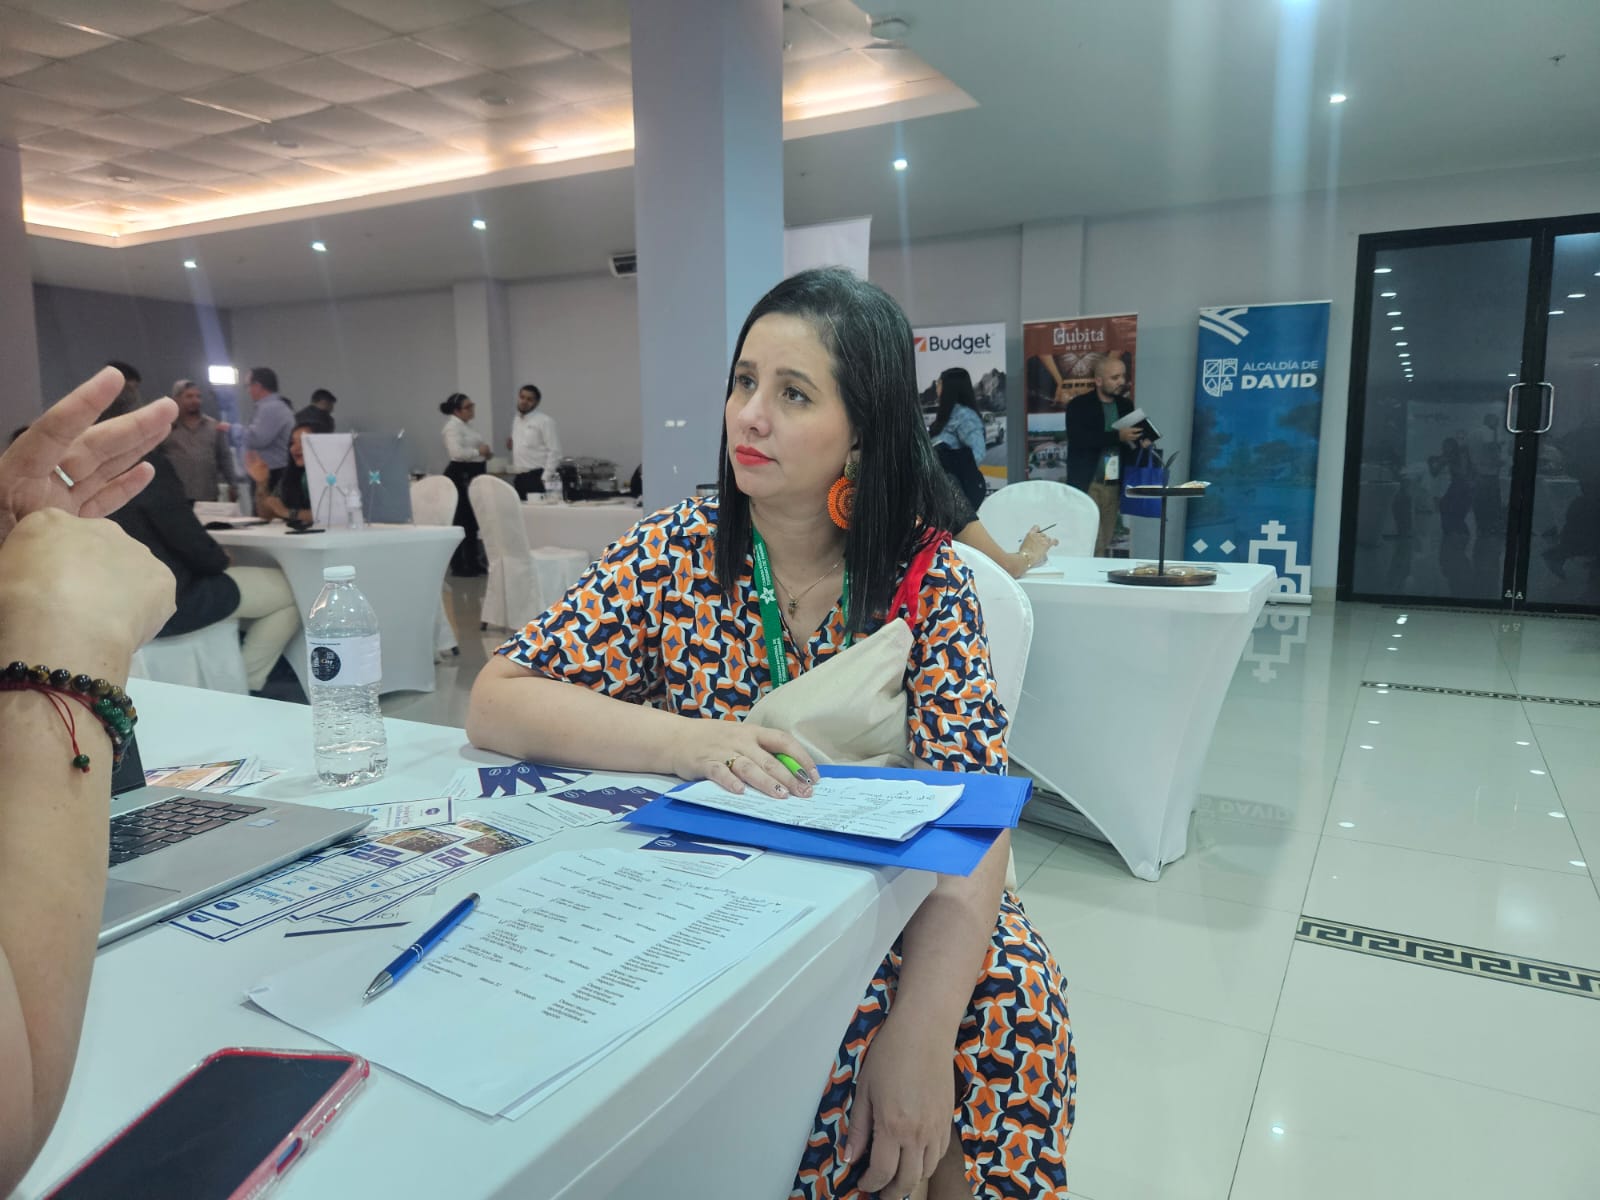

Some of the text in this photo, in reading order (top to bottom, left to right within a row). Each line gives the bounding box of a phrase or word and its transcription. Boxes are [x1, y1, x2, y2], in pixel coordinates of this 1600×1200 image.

[929, 333, 991, 354] Budget
[1242, 360, 1319, 371] ALCALDÍA DE
[1241, 373, 1318, 389] DAVID
